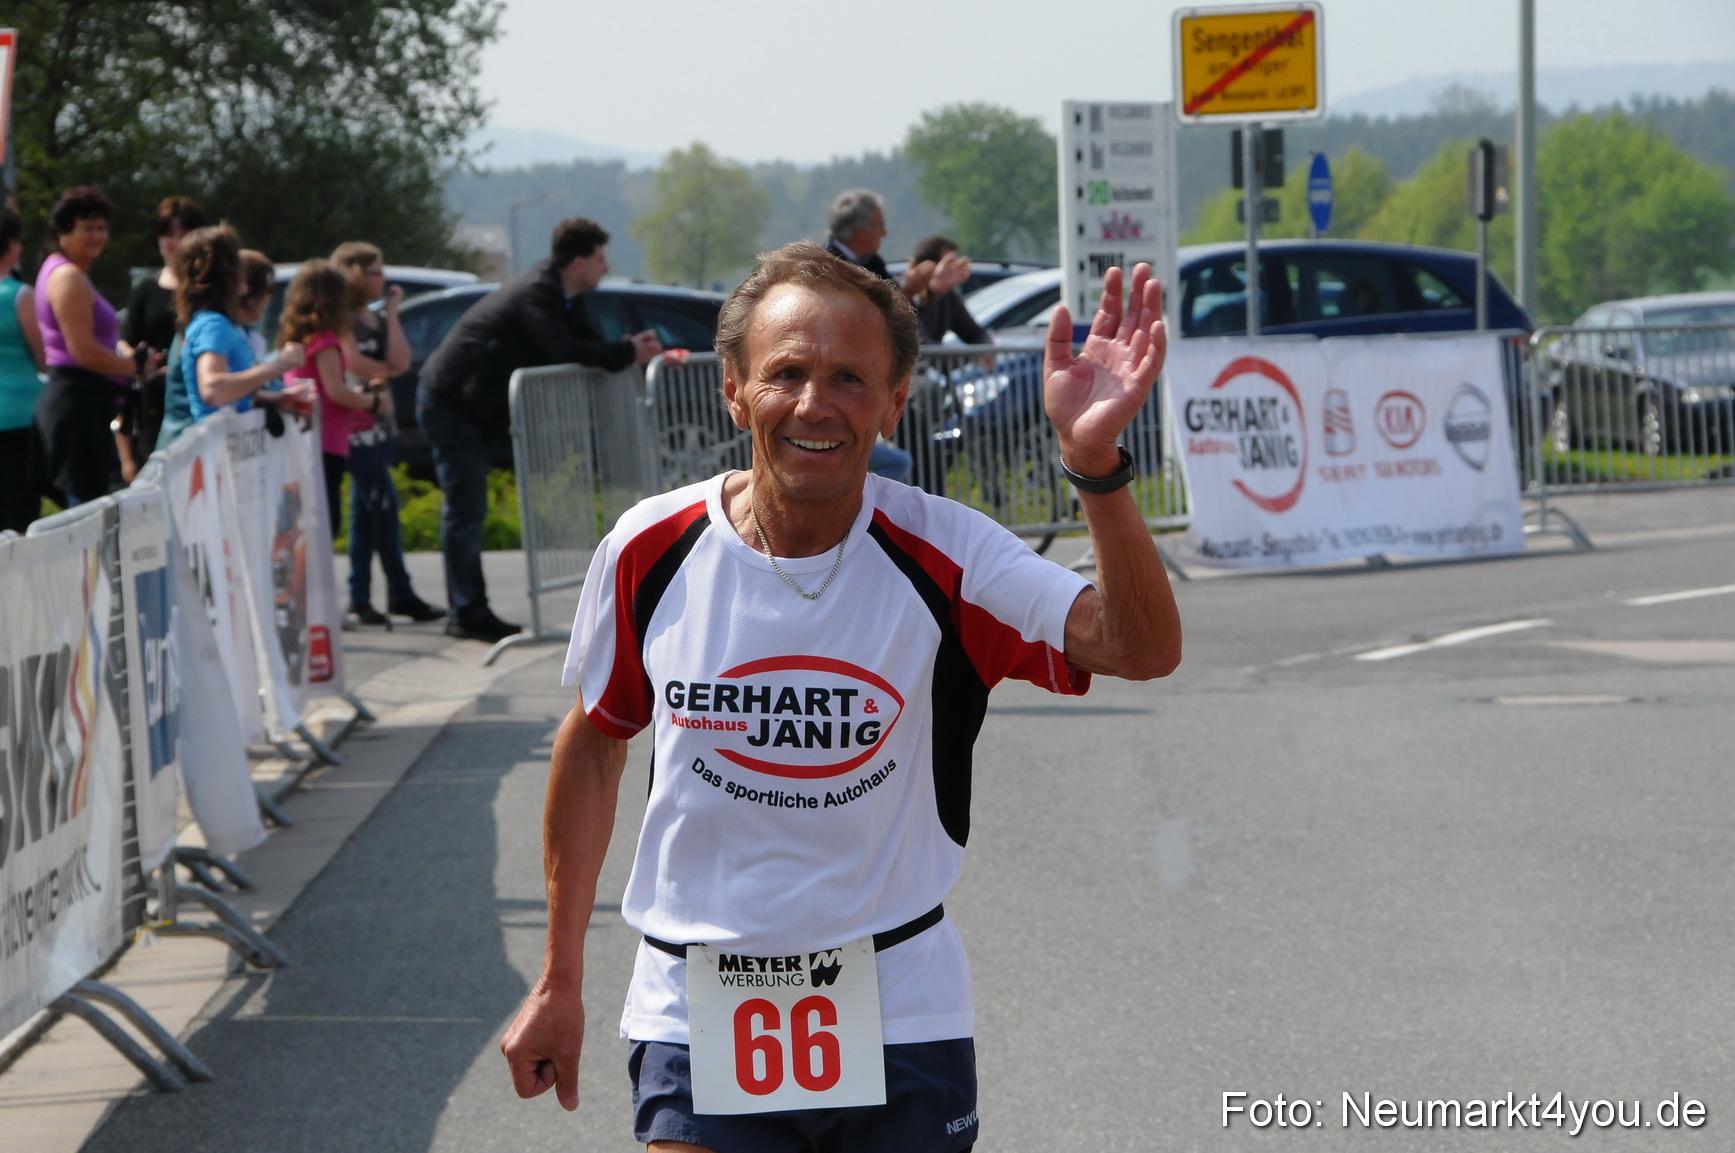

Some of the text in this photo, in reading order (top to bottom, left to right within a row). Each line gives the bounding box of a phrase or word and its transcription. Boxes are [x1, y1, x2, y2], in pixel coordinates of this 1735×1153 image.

[1185, 396, 1279, 432] GERHART
[1386, 405, 1417, 434] KIA
[665, 680, 880, 717] GERHART &
[671, 712, 748, 732] Autohaus
[747, 718, 881, 749] JÄNIG
[691, 757, 897, 809] Das sportliche Autohaus
[718, 953, 803, 973] MEYER
[719, 973, 805, 988] WERBUNG
[733, 994, 842, 1096] 66
